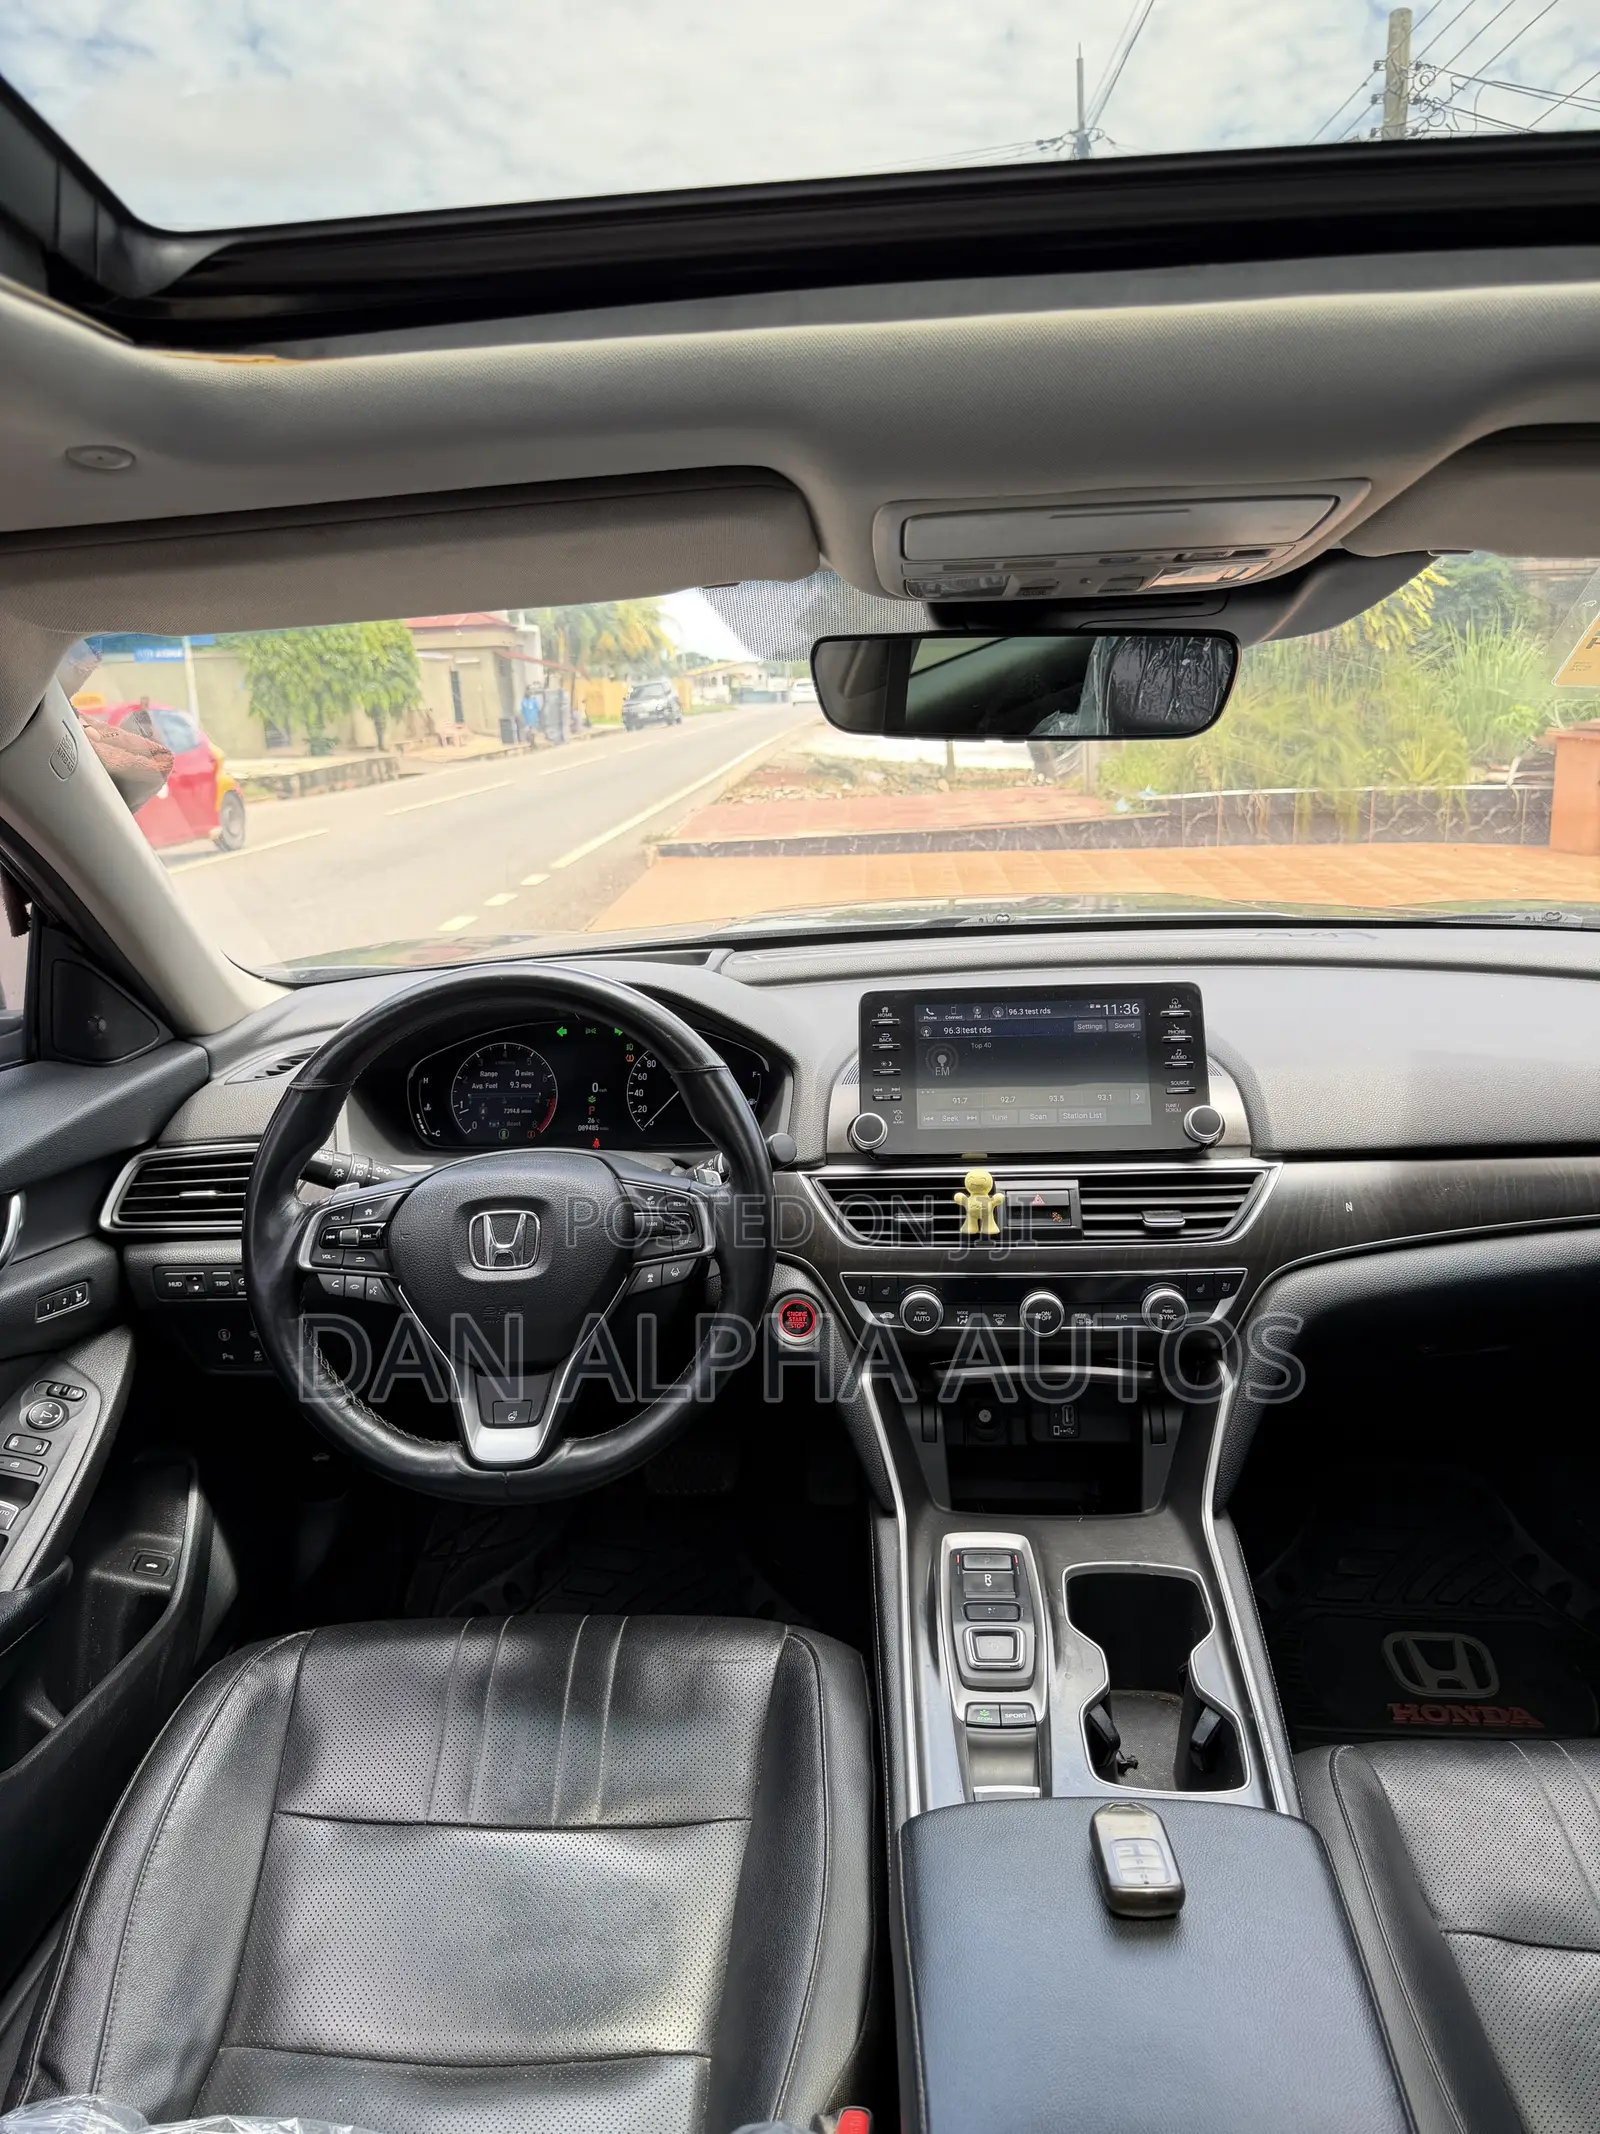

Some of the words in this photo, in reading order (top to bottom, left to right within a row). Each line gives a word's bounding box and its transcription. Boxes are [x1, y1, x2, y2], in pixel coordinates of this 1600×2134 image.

[1103, 1003, 1140, 1015] 11:36
[1077, 1023, 1103, 1031] Settings
[1114, 1022, 1135, 1030] Sound
[943, 1027, 961, 1035] 96.3
[962, 1026, 978, 1034] test
[979, 1026, 992, 1034] rds
[971, 1042, 983, 1050] Top
[646, 1060, 657, 1068] 80
[480, 1070, 498, 1078] Range
[515, 1069, 520, 1077] 0
[935, 1066, 950, 1076] FM
[592, 1082, 599, 1093] 0
[588, 1106, 596, 1115] P
[637, 1105, 648, 1113] 20
[1062, 1112, 1088, 1120] Station
[472, 1121, 478, 1130] 0
[984, 1574, 992, 1582] R
[1386, 1703, 1545, 1729] HONDA
